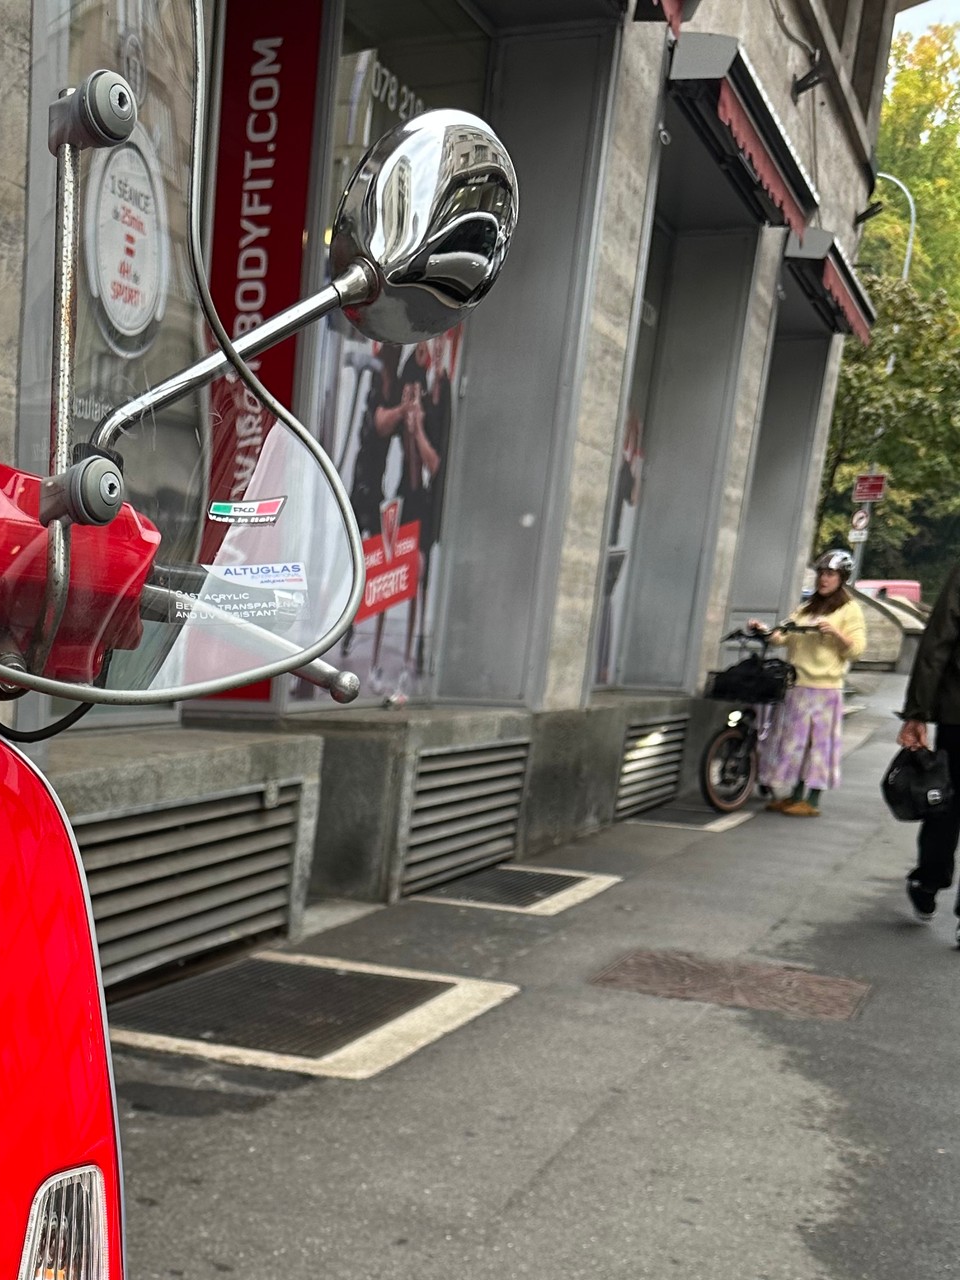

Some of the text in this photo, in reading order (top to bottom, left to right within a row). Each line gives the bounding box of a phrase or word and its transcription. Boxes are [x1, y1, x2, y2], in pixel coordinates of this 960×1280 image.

[371, 60, 399, 112] 078
[208, 514, 235, 523] Made
[250, 515, 276, 523] Italy
[223, 564, 302, 577] ALTUGLAS
[204, 592, 250, 603] ACRYLIC
[175, 611, 198, 620] AND
[225, 609, 278, 620] SISTANT
